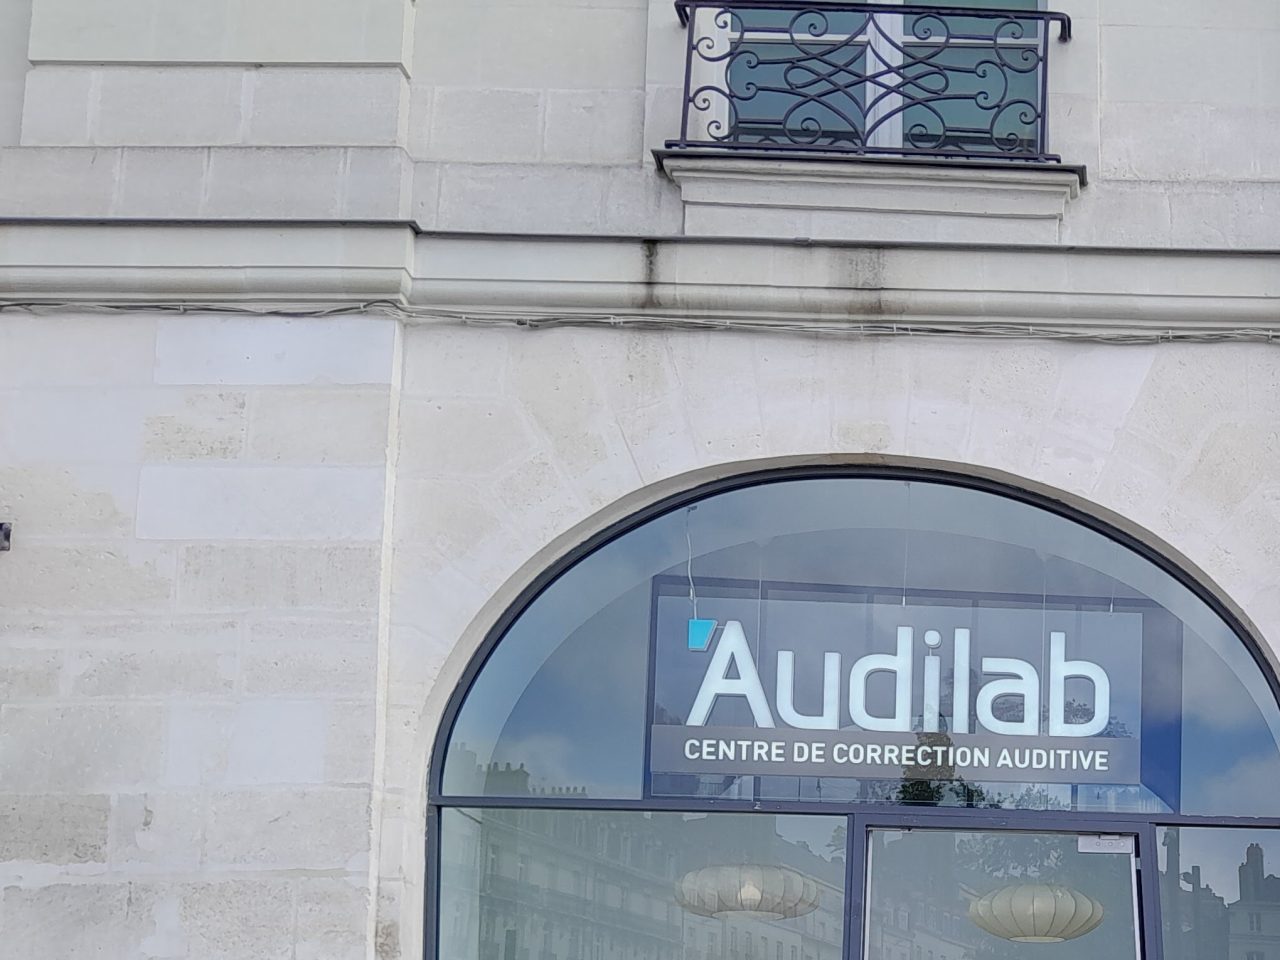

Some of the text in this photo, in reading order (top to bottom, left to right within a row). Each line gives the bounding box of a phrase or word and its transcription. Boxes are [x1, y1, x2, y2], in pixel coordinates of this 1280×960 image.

[685, 619, 1111, 738] Audilab
[684, 739, 1110, 771] CENTRE DE CORRECTION AUDITIVE
